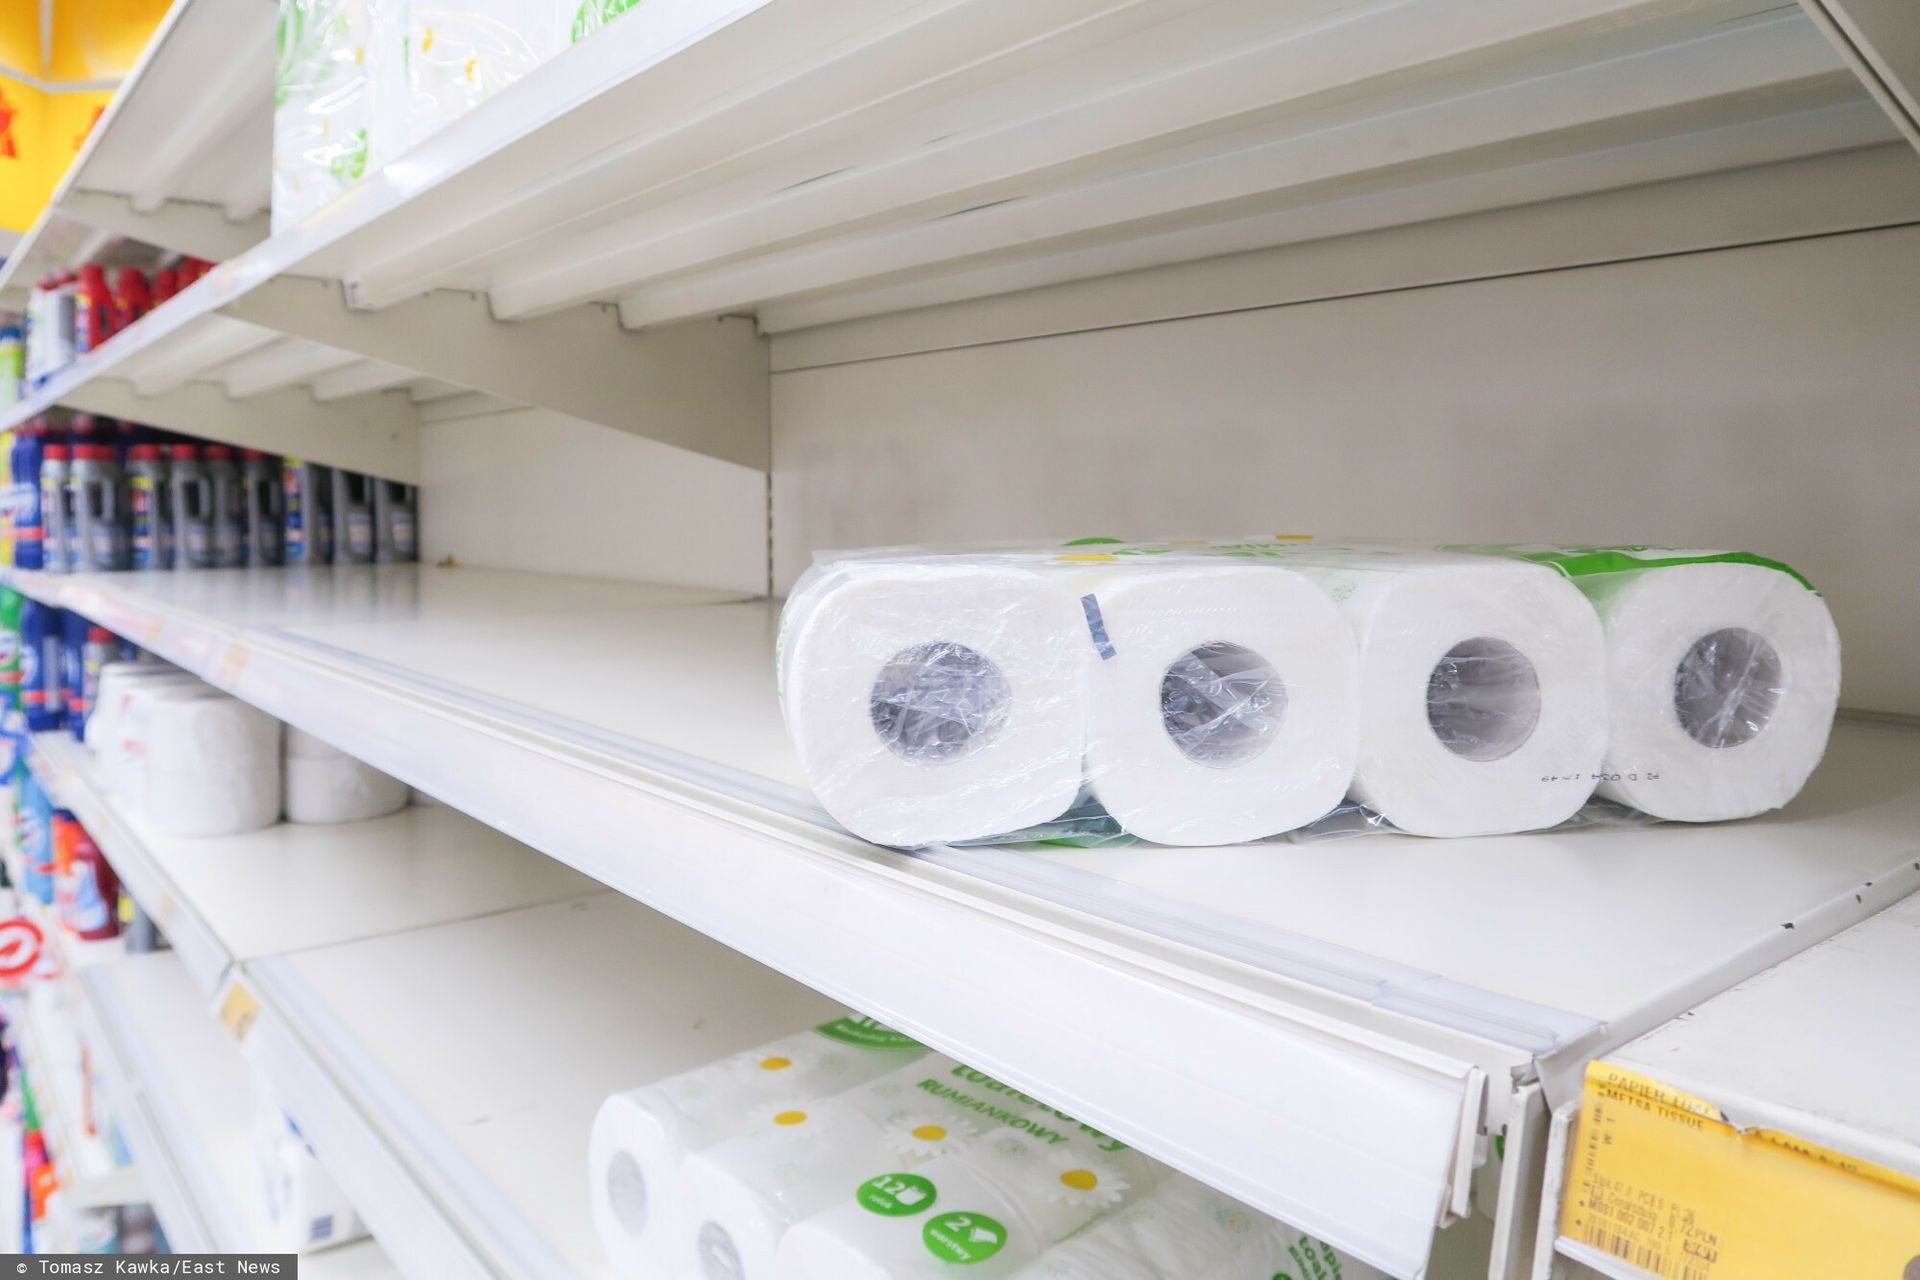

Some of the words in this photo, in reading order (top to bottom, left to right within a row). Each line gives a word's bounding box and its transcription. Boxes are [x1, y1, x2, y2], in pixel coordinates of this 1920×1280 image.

[1607, 1073, 1665, 1103] PAPIER
[917, 1078, 1070, 1144] RUMIANKOWY
[872, 1176, 905, 1195] 12
[944, 1216, 972, 1232] 2
